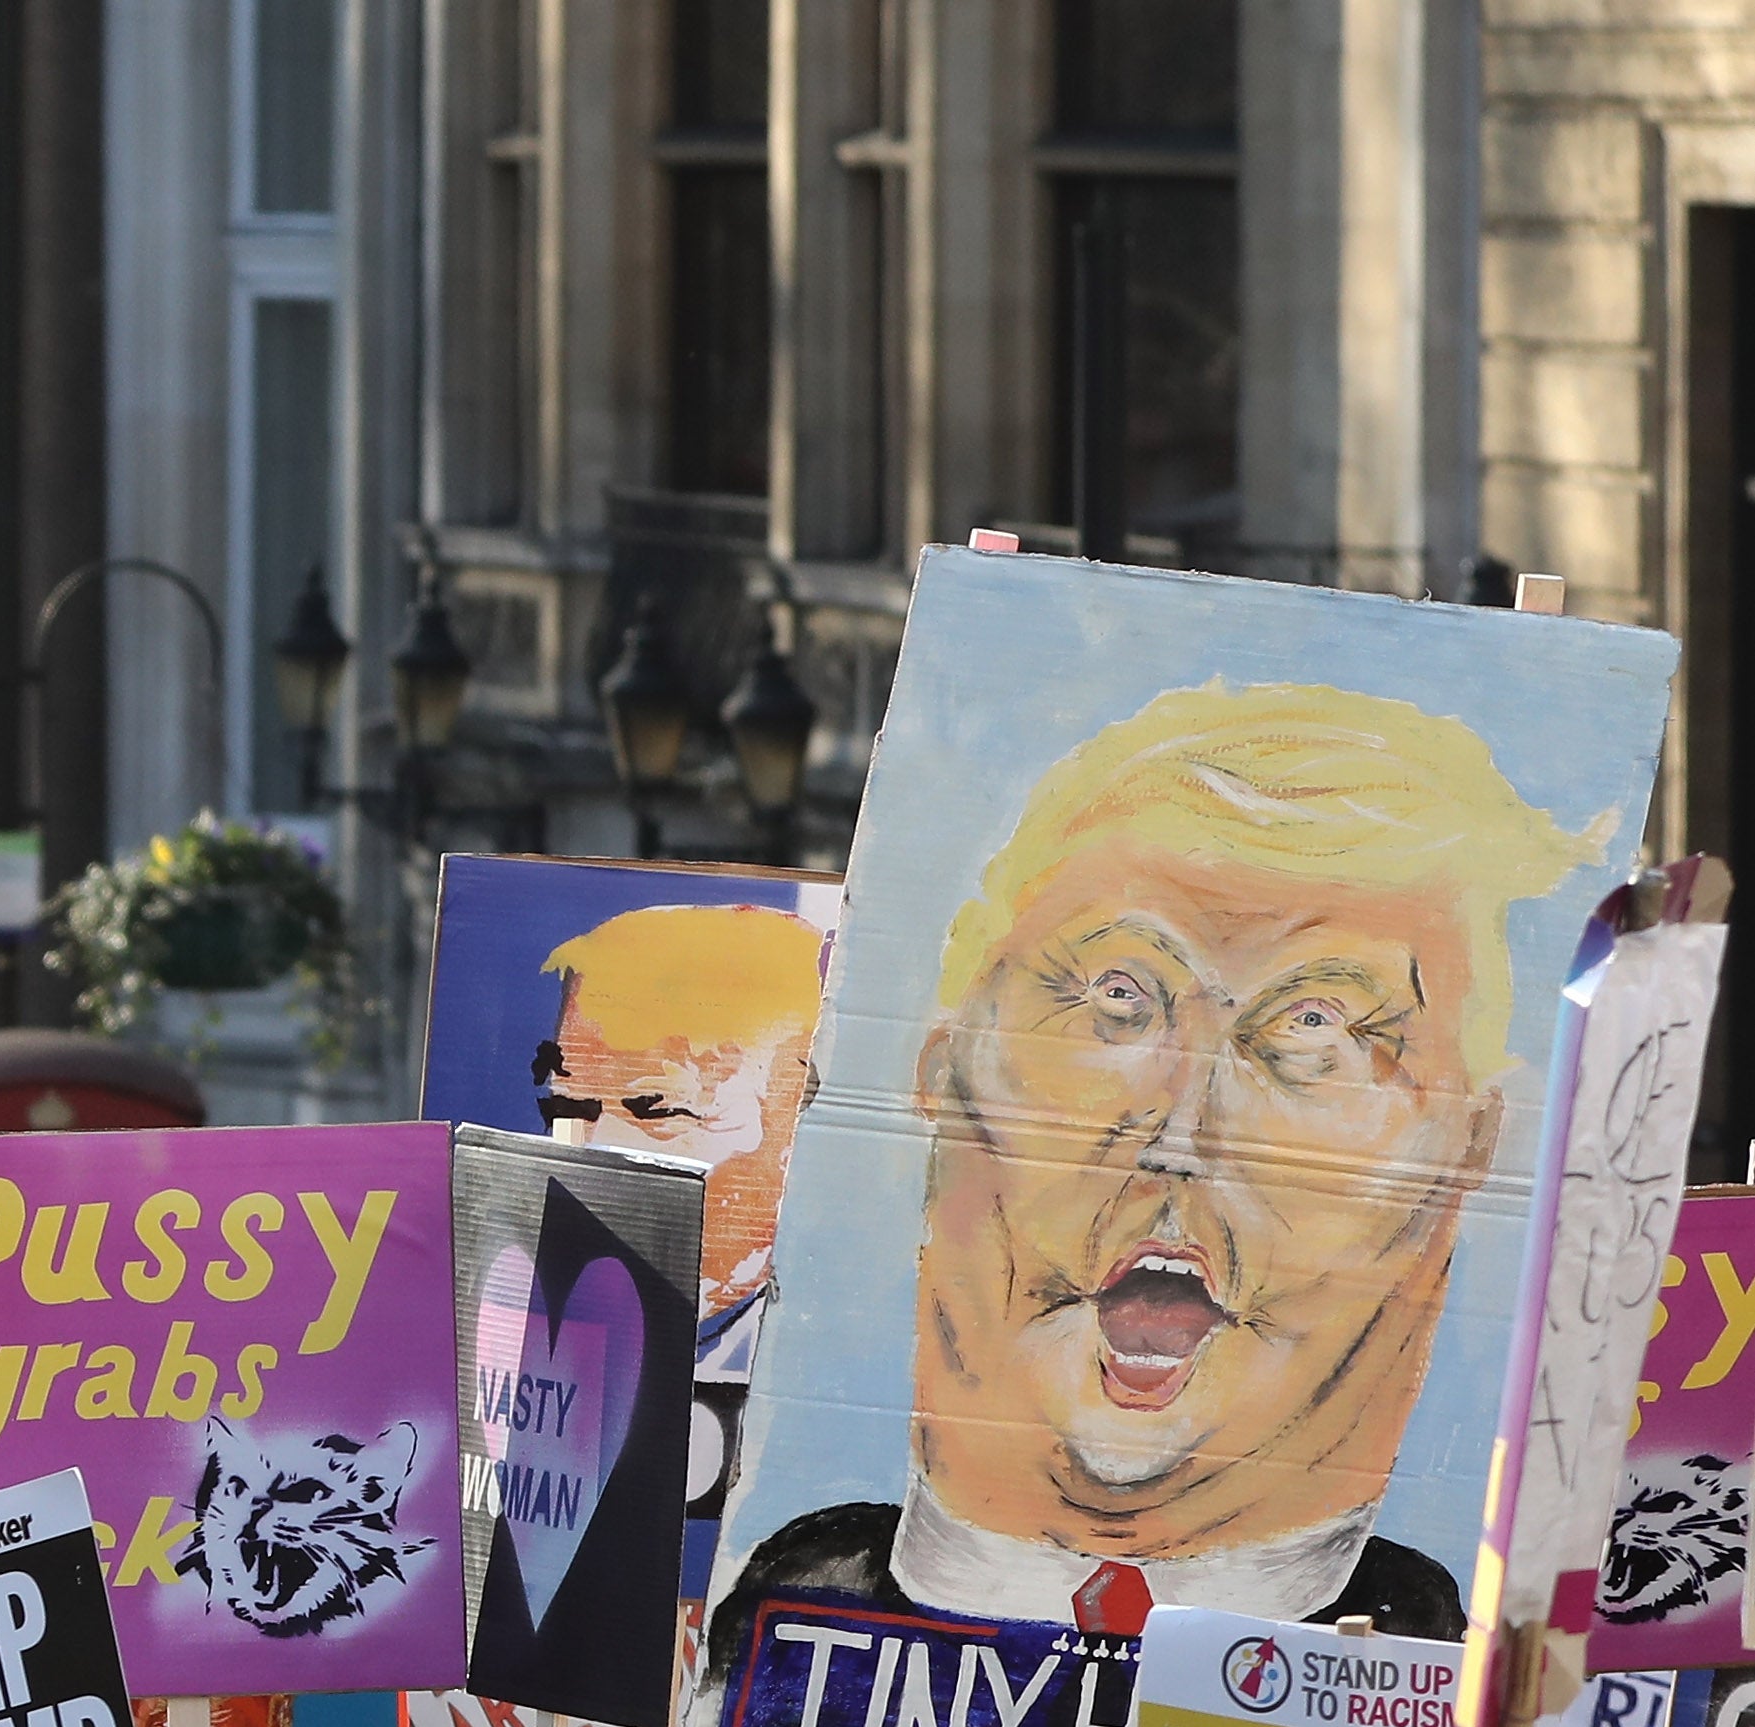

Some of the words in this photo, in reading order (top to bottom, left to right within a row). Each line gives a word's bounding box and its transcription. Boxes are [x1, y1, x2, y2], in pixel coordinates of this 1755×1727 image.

[474, 1364, 578, 1441] NASTY
[461, 1453, 584, 1534] WOMAN
[1302, 1651, 1399, 1692] STAND
[1409, 1663, 1453, 1696] UP
[1302, 1686, 1339, 1721] TO
